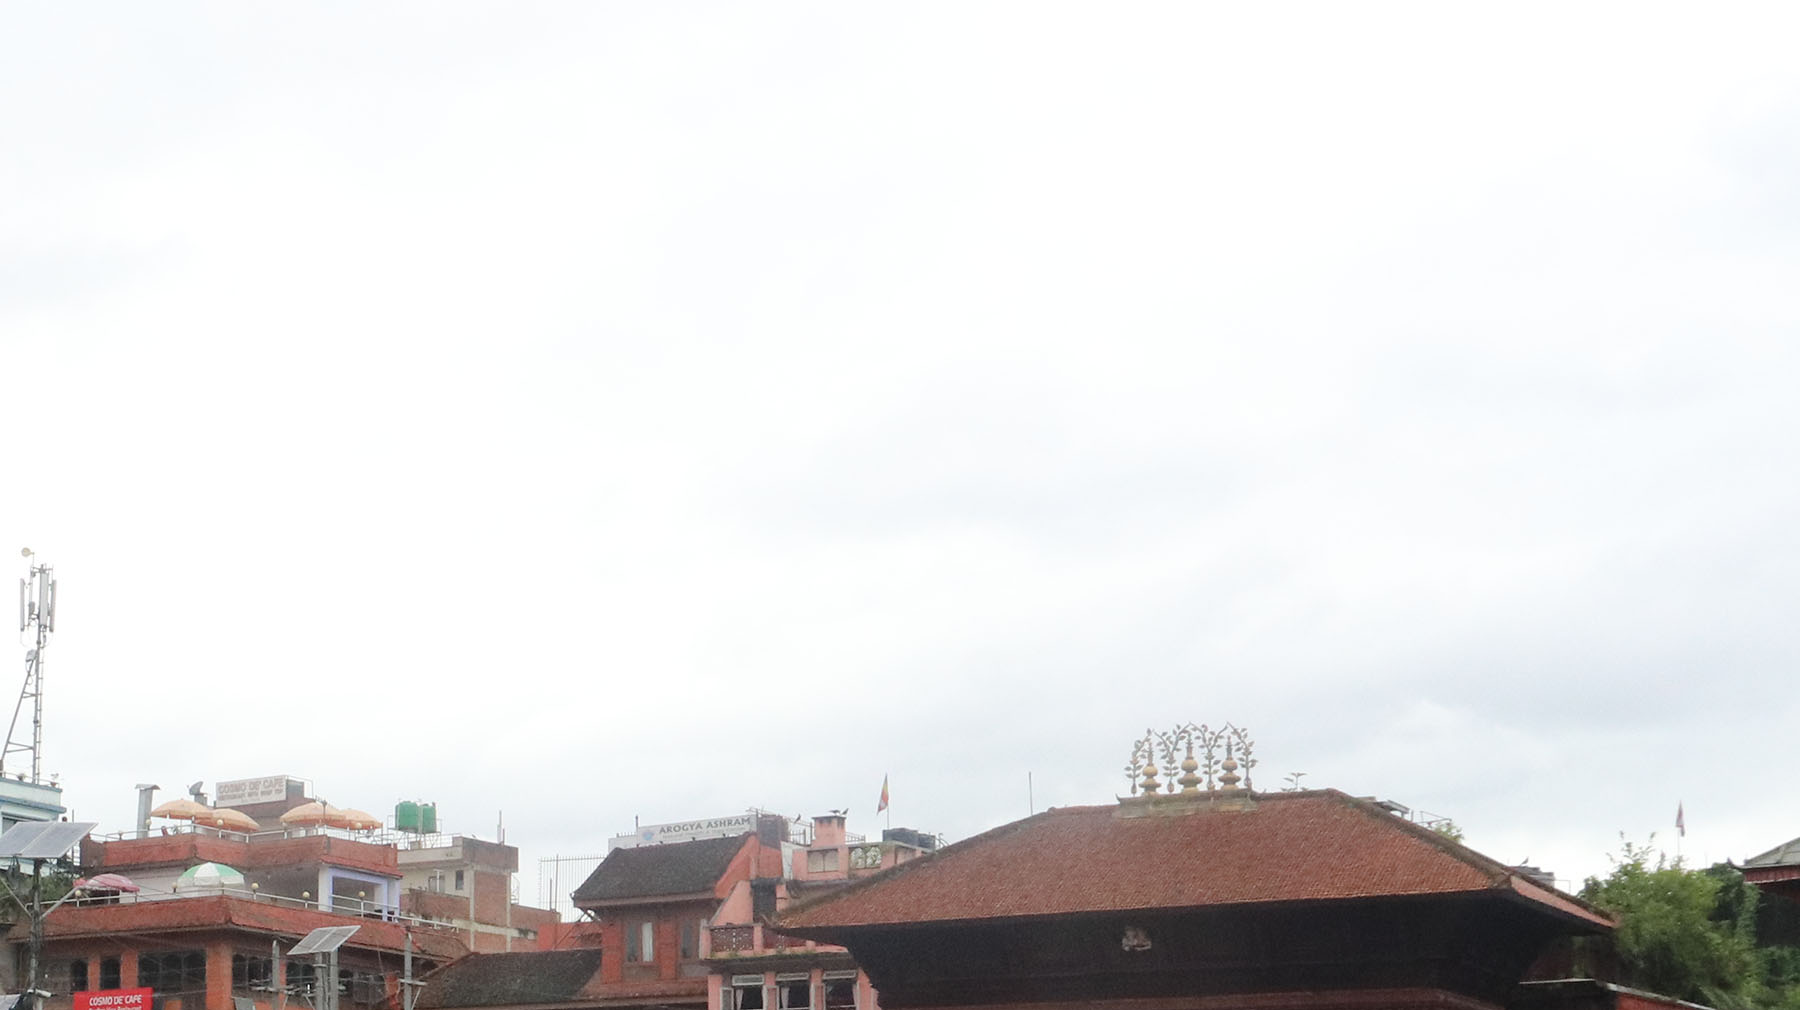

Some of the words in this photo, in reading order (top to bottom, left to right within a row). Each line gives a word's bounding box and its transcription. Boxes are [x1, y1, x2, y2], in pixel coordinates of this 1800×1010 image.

[659, 823, 703, 834] AROGYA
[706, 817, 750, 829] ASHRAM
[89, 996, 113, 1006] COSMO
[113, 995, 123, 1005] DE
[124, 994, 142, 1004] CAFE
